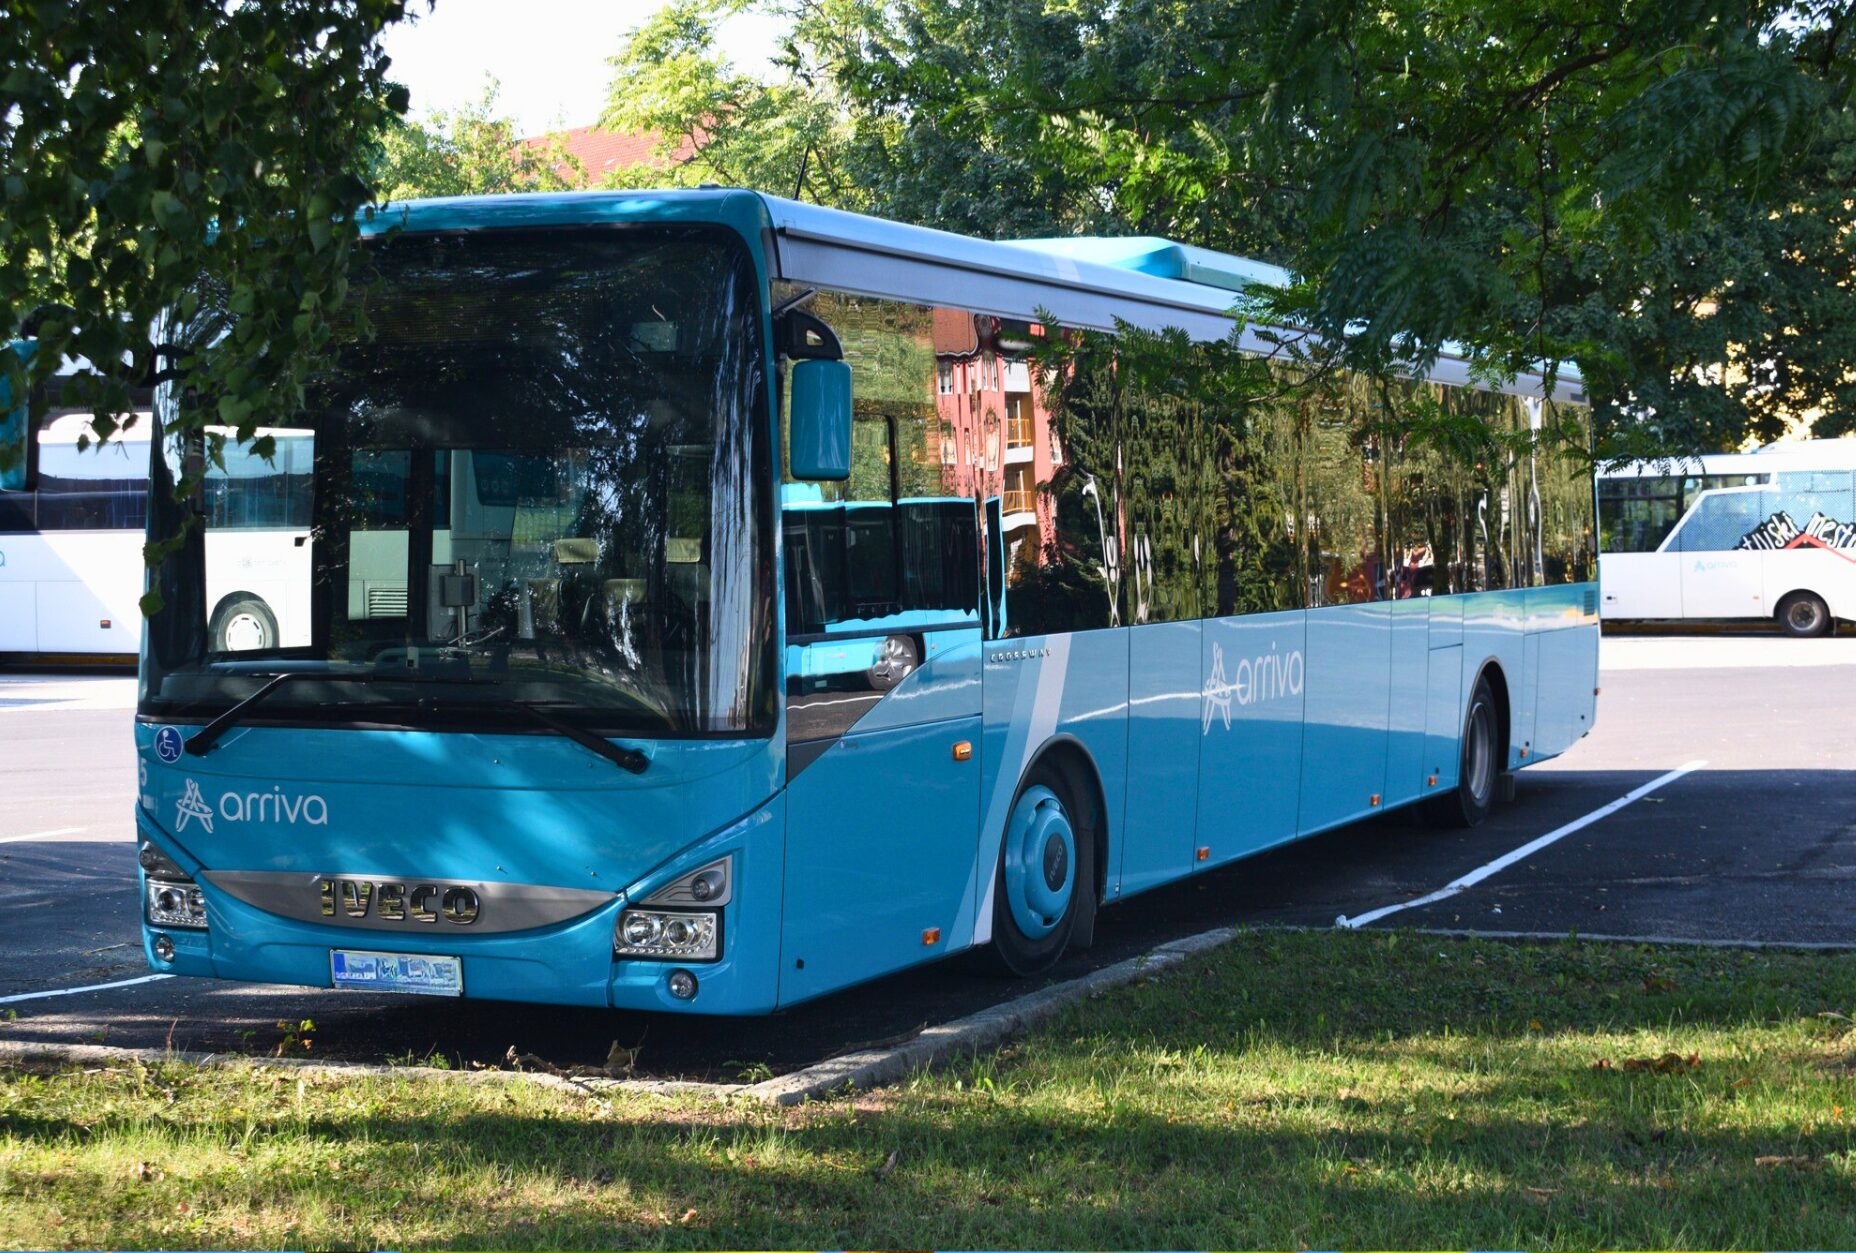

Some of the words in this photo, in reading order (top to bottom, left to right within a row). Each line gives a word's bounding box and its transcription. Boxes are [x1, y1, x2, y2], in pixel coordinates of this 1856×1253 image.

[990, 647, 1053, 663] CROSSWAY
[1236, 640, 1304, 706] arriva
[219, 785, 328, 825] arriva
[1049, 844, 1063, 881] IVECO
[320, 880, 480, 925] IVECO
